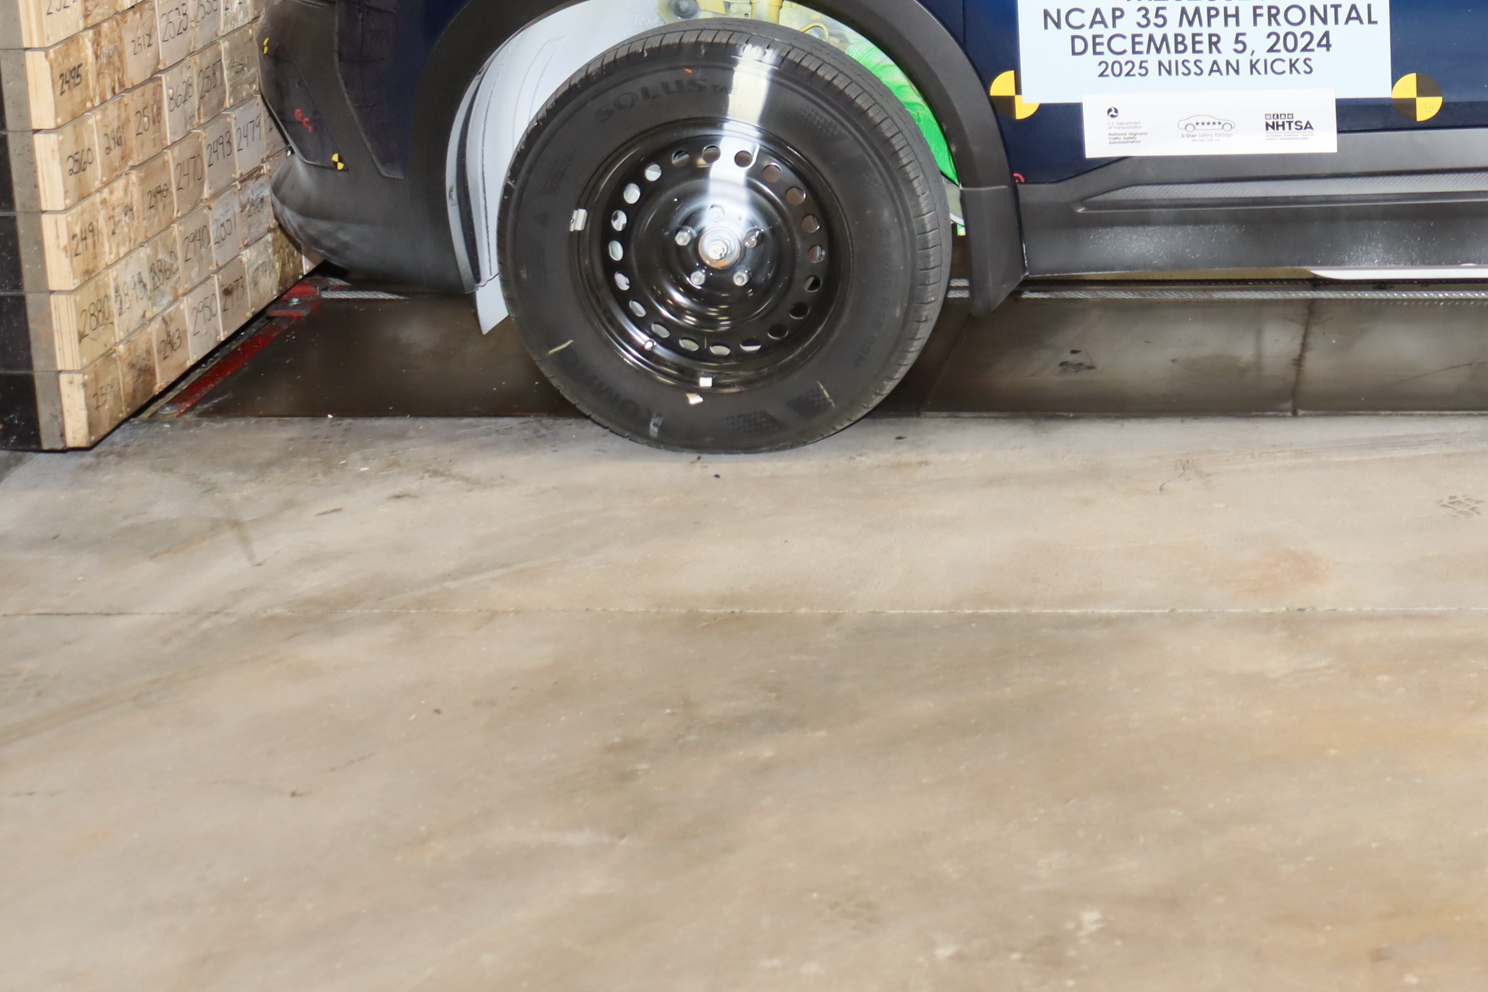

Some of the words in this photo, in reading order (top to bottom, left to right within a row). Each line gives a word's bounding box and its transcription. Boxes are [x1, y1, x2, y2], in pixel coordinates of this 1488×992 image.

[1043, 7, 1126, 31] NCAP
[1135, 6, 1168, 28] 35
[1178, 6, 1241, 27] MPH
[1252, 3, 1379, 26] FRONTAL
[131, 33, 154, 56] 2512
[1070, 32, 1222, 56] DECEMBER
[1232, 31, 1256, 57] 5,
[1266, 30, 1332, 53] 2024
[1097, 60, 1150, 78] 2025
[1157, 58, 1240, 77] NISSAN
[1249, 57, 1314, 76] KICKS
[594, 78, 708, 122] SOLUS
[236, 114, 261, 152] 2479
[1265, 120, 1314, 131] NHTSA
[206, 130, 232, 168] 2493
[72, 219, 100, 257] 2491
[183, 225, 210, 262] 2940
[80, 294, 111, 340] 2880
[191, 293, 217, 336] 2950
